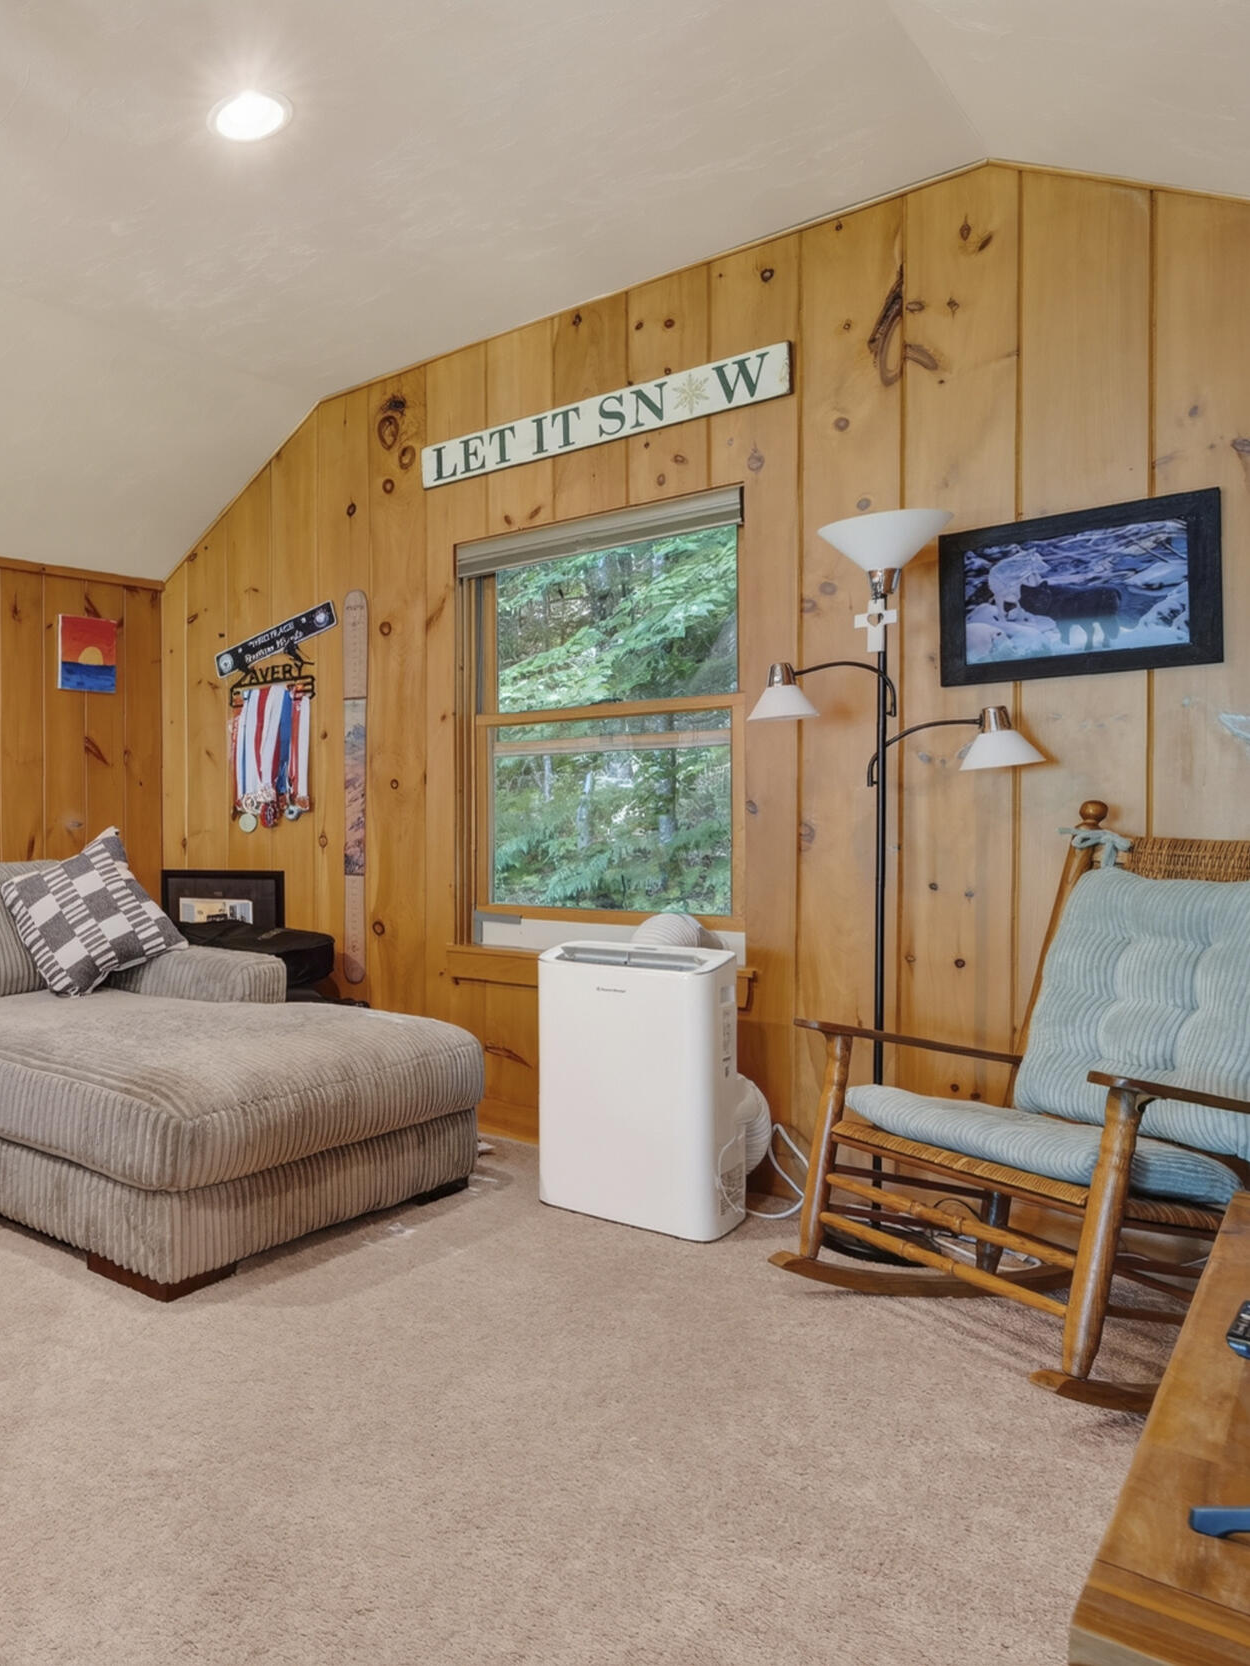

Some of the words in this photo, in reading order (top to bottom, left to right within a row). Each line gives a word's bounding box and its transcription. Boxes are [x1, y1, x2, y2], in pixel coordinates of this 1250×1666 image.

[432, 425, 516, 482] LET
[531, 406, 581, 456] IT
[598, 352, 769, 438] SNW
[249, 662, 305, 683] AVERY
